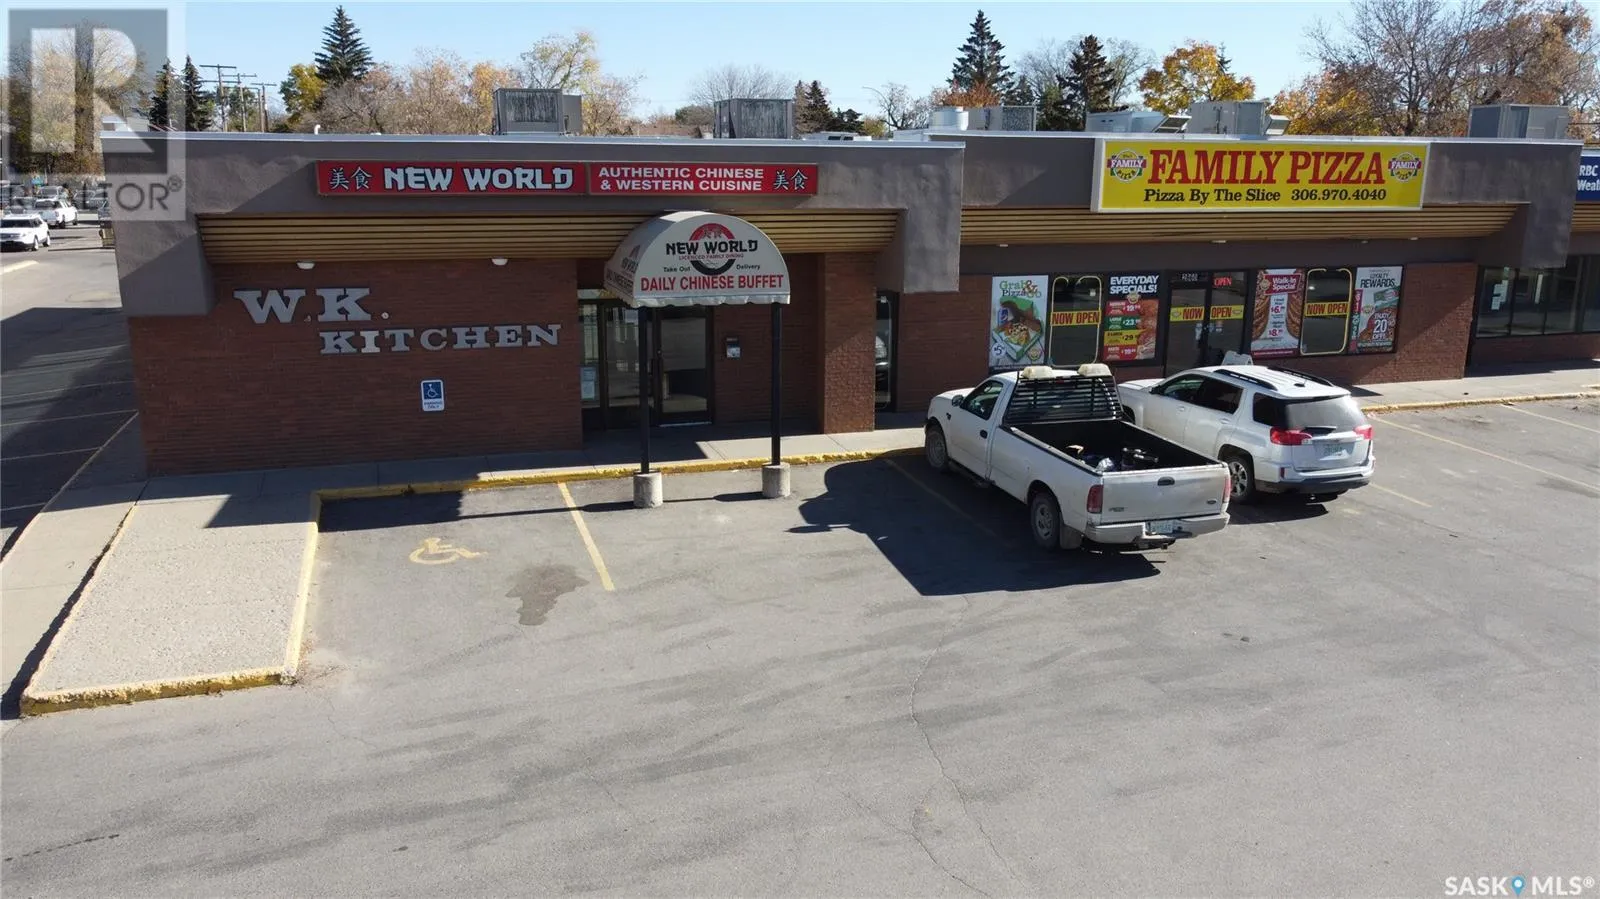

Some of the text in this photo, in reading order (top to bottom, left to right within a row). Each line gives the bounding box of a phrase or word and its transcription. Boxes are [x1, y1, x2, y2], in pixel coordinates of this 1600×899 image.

[1110, 159, 1143, 168] FAMILY
[1147, 149, 1386, 185] FAMILY PIZZA
[1391, 160, 1419, 169] FAMILY
[598, 167, 764, 179] AUTHENTIC CHINESE
[1579, 164, 1599, 177] RBC
[329, 165, 373, 191] 美食
[383, 166, 573, 191] NEW WORLD
[772, 168, 809, 191] 美食
[600, 179, 762, 191] & WESTERN CUISINE
[1576, 179, 1600, 191] Weal
[1143, 188, 1387, 205] Pizza By The Slice 306.970.4040
[665, 239, 759, 256] NEW WORLD
[679, 265, 692, 273] Out
[736, 263, 761, 271] Delivery
[640, 275, 677, 292] DAILY
[680, 275, 734, 291] CHINESE
[738, 274, 784, 289] BUFFET
[1110, 274, 1159, 285] EVERYDAY
[1214, 277, 1232, 286] OPEN
[1360, 278, 1395, 288] REWARDS
[1109, 284, 1158, 295] SPECIALS!
[1183, 307, 1232, 320] NOW OPEN
[1306, 302, 1348, 314] NOW OPEN
[1052, 312, 1100, 325] NOW OPEN
[1373, 319, 1388, 333] 20
[319, 323, 562, 355] KITCHEN
